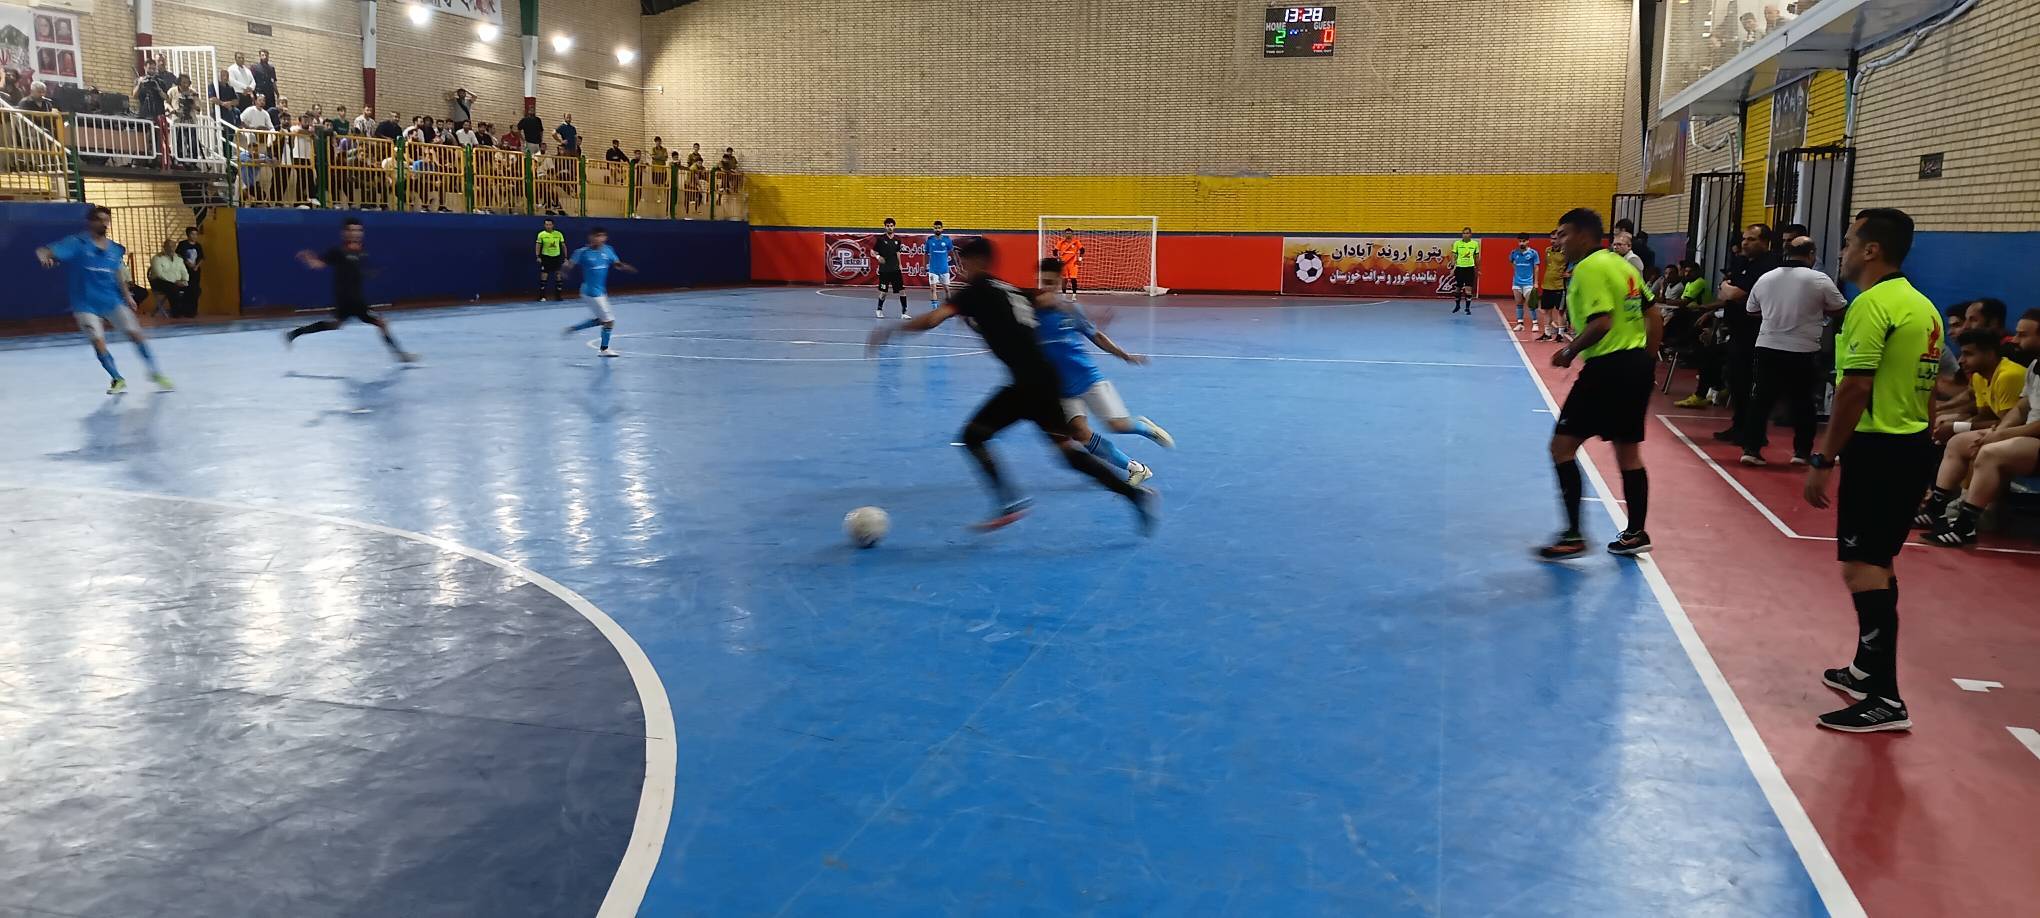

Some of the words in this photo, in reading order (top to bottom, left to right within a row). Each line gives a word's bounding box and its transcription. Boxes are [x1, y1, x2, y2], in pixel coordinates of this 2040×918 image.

[1285, 7, 1323, 22] 13:28
[1266, 22, 1287, 31] HOME
[1313, 20, 1334, 30] GUEST
[1275, 30, 1287, 44] 2
[1323, 29, 1334, 43] 0
[1331, 243, 1373, 261] آبادان
[1377, 244, 1412, 261] اروند
[1416, 246, 1442, 262] پترو
[1329, 269, 1361, 284] خوزستان
[1411, 270, 1437, 284] نماینده
